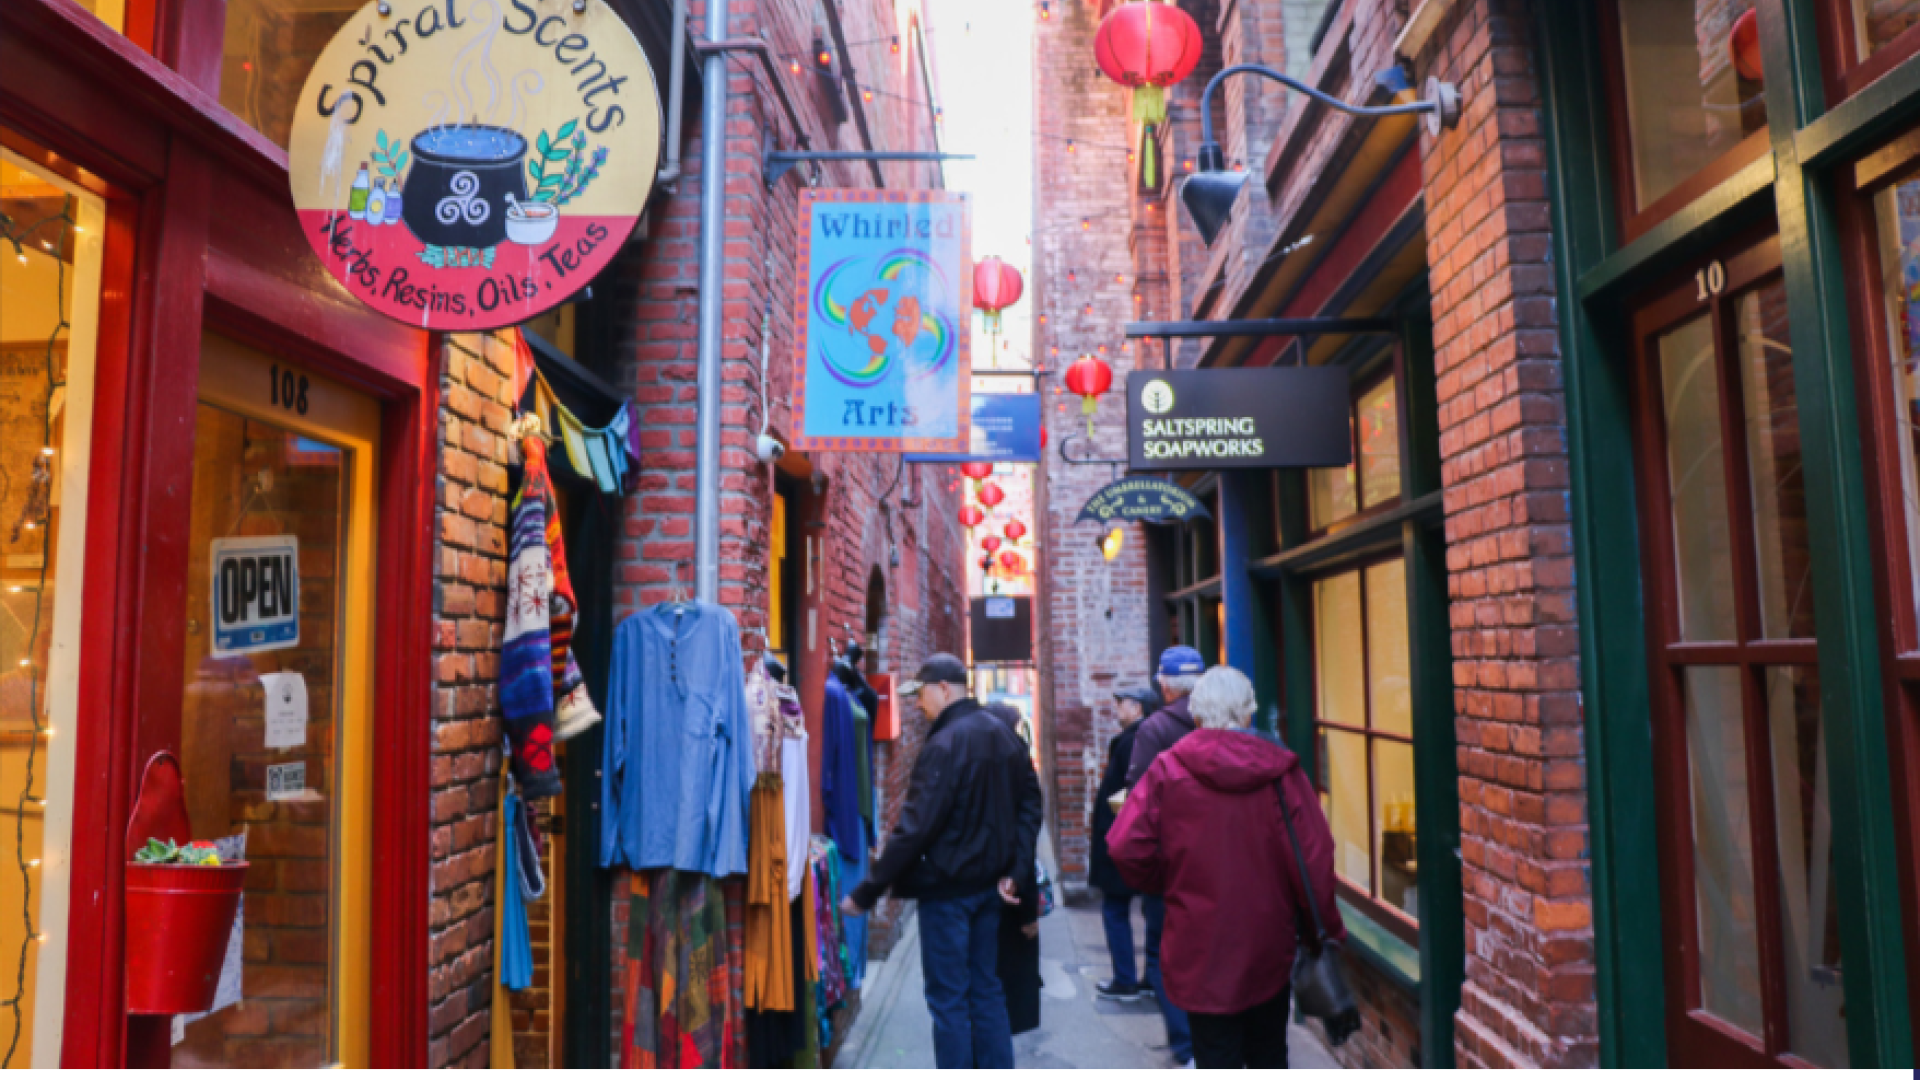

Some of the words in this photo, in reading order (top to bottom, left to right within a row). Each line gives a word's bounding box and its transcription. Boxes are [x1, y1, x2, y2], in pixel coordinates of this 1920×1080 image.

[316, 0, 466, 125] Spiral
[501, 0, 629, 133] Scents
[818, 212, 955, 239] Whirled
[381, 267, 475, 317] Resins,
[537, 222, 609, 278] Teas
[1694, 259, 1724, 301] 10
[268, 362, 309, 416] 108
[842, 398, 919, 427] Arts
[1142, 416, 1255, 438] SALTSPRING
[1143, 438, 1265, 458] SOAPWORKS
[220, 554, 292, 624] OPEN
